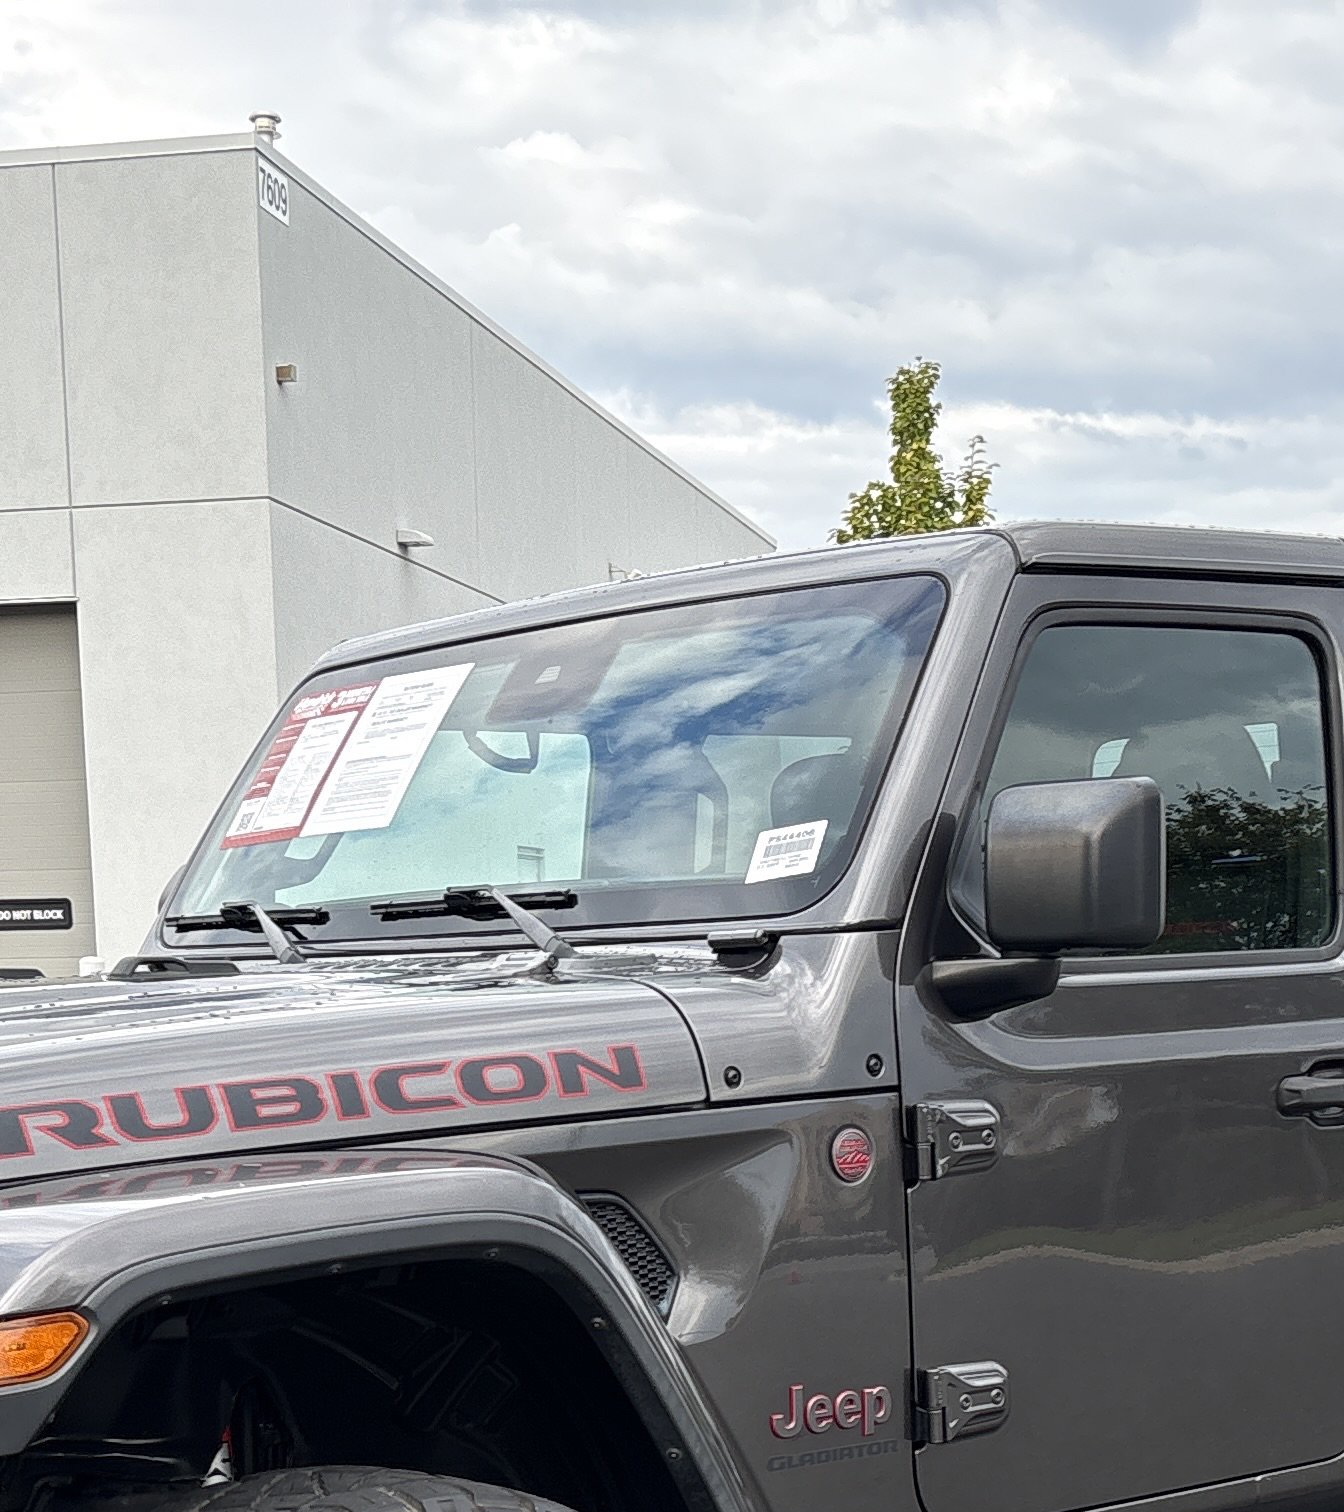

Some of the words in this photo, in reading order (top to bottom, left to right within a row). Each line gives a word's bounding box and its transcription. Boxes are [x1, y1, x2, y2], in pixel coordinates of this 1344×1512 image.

[259, 166, 288, 217] 7609
[12, 910, 32, 920] NOT
[33, 909, 64, 919] BLOCK
[769, 1383, 893, 1439] Jeep
[767, 1439, 899, 1472] GLADIATOR
